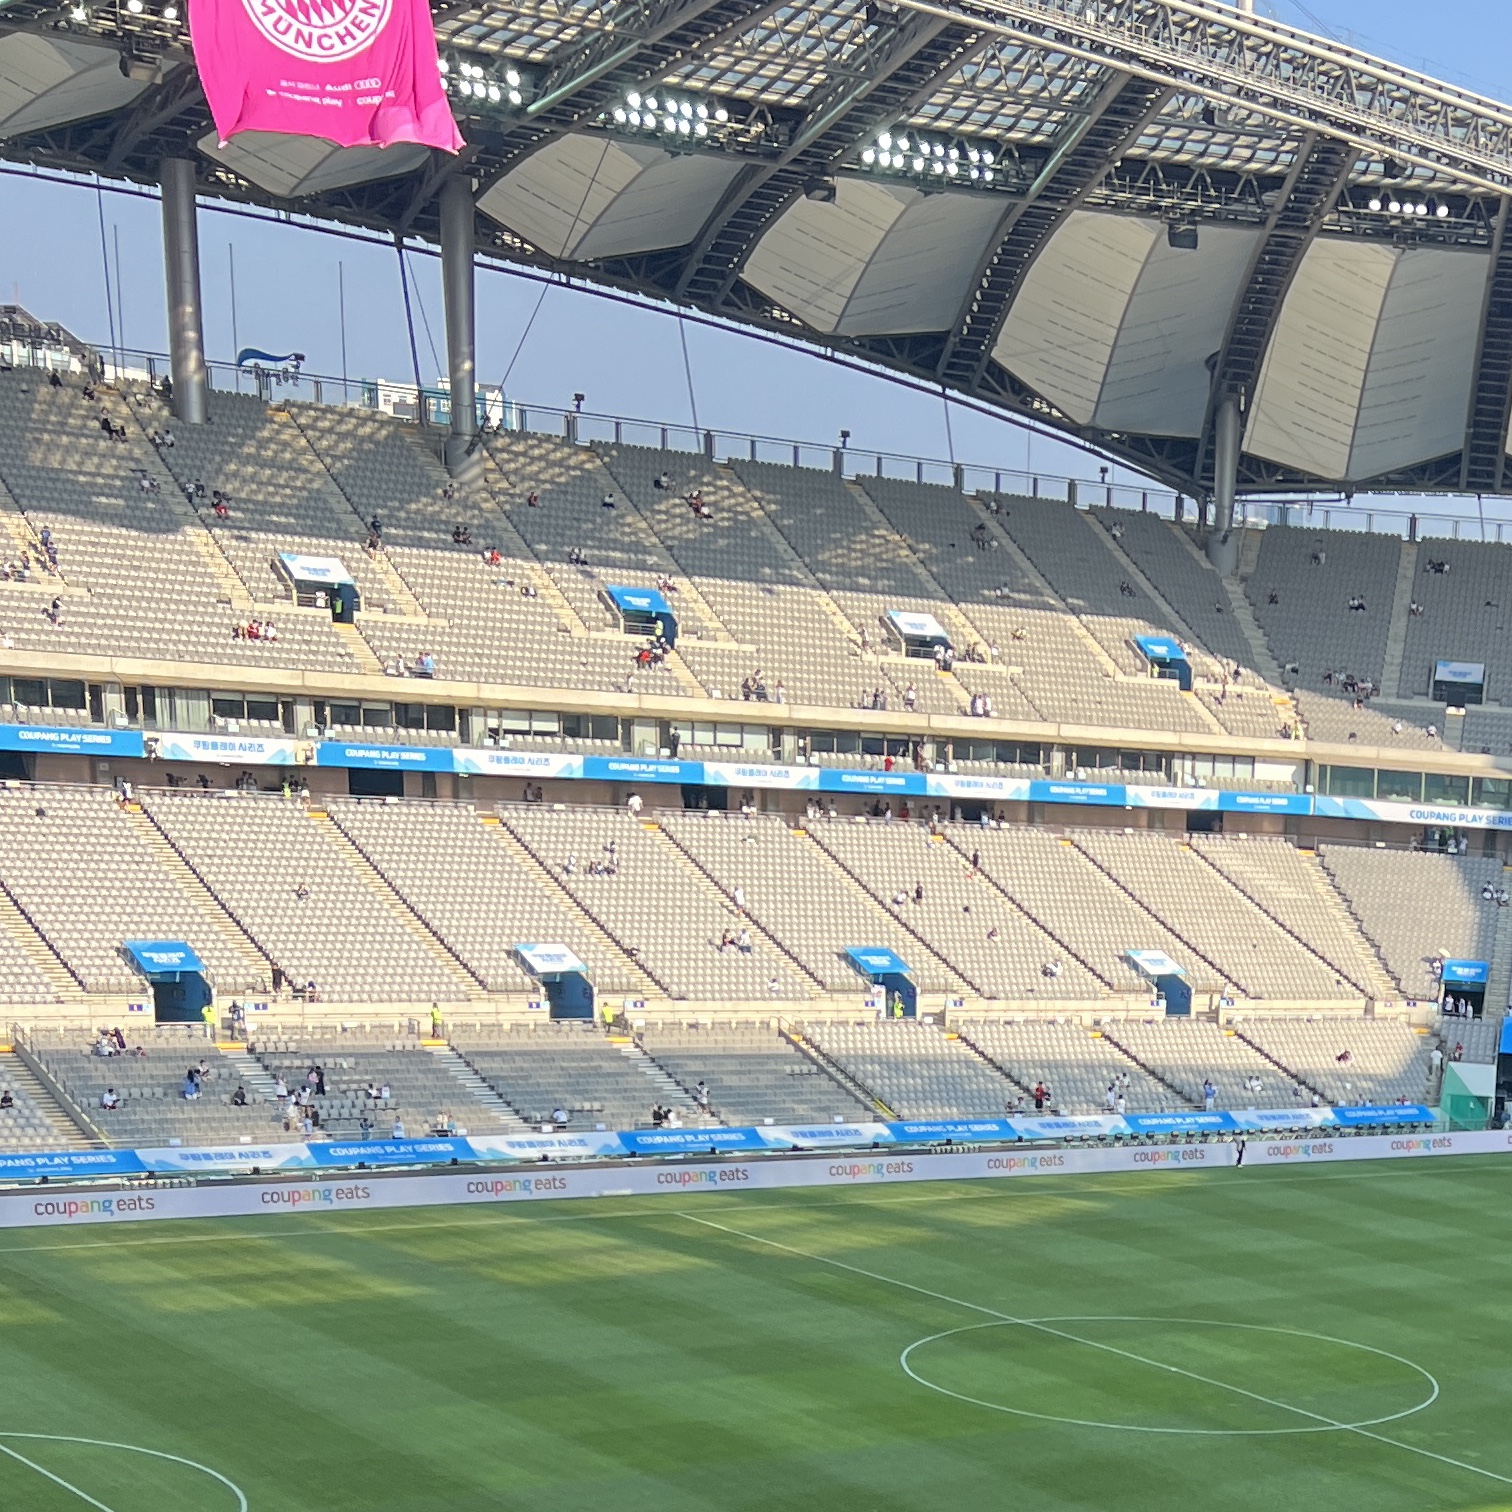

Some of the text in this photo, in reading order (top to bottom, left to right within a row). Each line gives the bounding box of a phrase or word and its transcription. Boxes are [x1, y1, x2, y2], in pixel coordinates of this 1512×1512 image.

[19, 731, 111, 743] COUPANG PLAY SERIES
[345, 749, 426, 761] COUPANG PLAY SERIES
[1410, 809, 1457, 822] COUPANG
[1458, 812, 1484, 824] PLAY
[636, 1132, 746, 1146] COUPANG PLAY SERIES
[1391, 1137, 1452, 1151] coupang eats
[329, 1143, 454, 1157] COUPANG PLAY SERIES
[1133, 1148, 1205, 1165] coupang eats
[1267, 1142, 1333, 1158] coupang eats
[36, 1156, 69, 1166] PLAY
[71, 1154, 117, 1164] SERIES
[987, 1154, 1065, 1172] coupang eats
[657, 1167, 749, 1186] coupang eats
[829, 1160, 914, 1178] coupang eats
[467, 1176, 567, 1196] coupang eats
[261, 1184, 371, 1206] coupang eats
[34, 1195, 155, 1217] coupang eats
